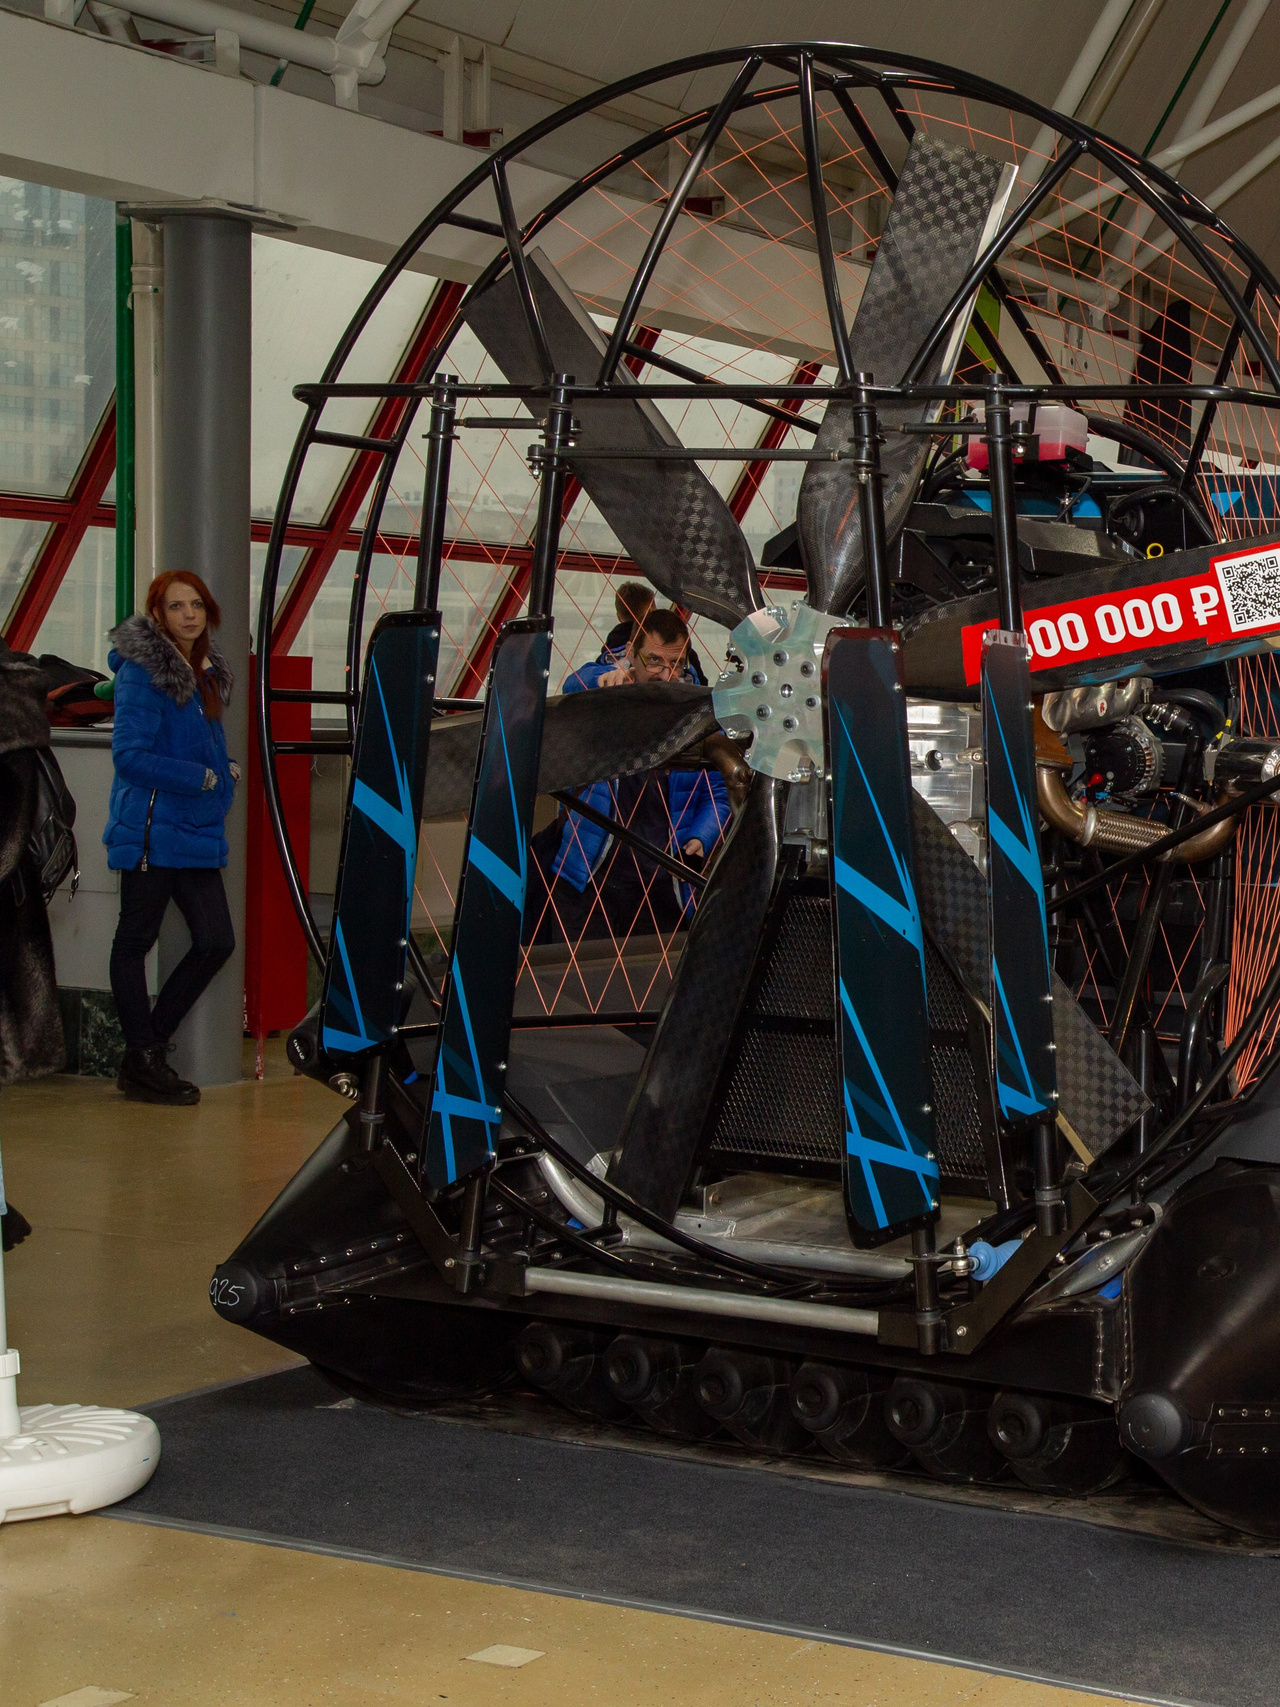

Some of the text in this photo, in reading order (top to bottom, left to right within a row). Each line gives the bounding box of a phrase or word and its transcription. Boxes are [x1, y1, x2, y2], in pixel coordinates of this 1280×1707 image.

[1023, 585, 1220, 659] 00 000 ₽
[209, 1278, 246, 1307] 925
